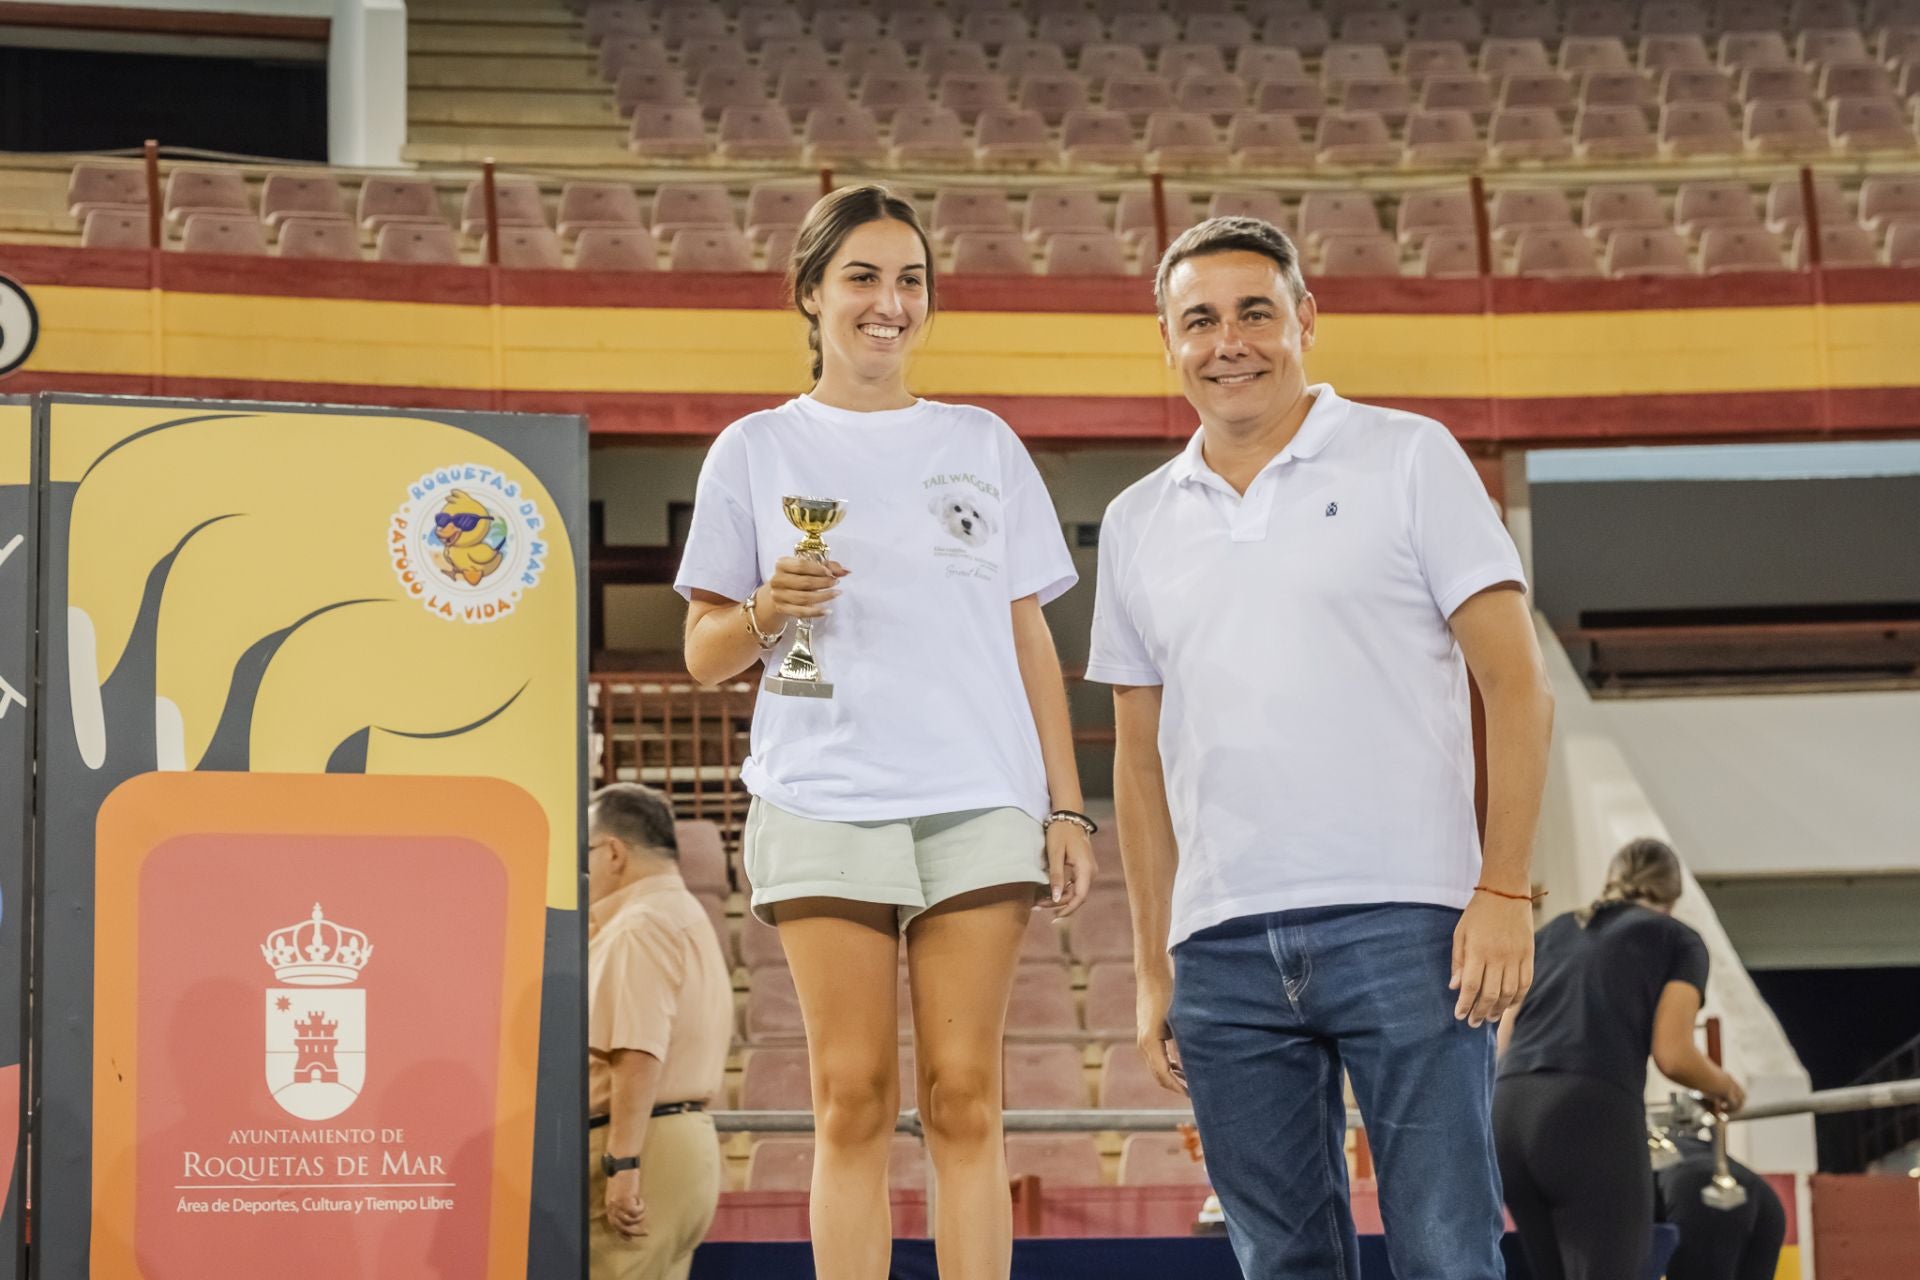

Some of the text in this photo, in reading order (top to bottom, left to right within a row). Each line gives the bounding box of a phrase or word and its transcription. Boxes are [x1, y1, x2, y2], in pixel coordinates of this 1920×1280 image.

[923, 474, 948, 490] TAIL
[411, 467, 543, 585] ROQUETAS DE MAR
[427, 595, 453, 616] LA
[464, 599, 511, 620] VIDA
[228, 1128, 405, 1145] AYUNTAMIENTO DE
[336, 1156, 369, 1177] DE
[176, 1195, 454, 1216] Área de Deportes, Cultura y Tiempo Libre
